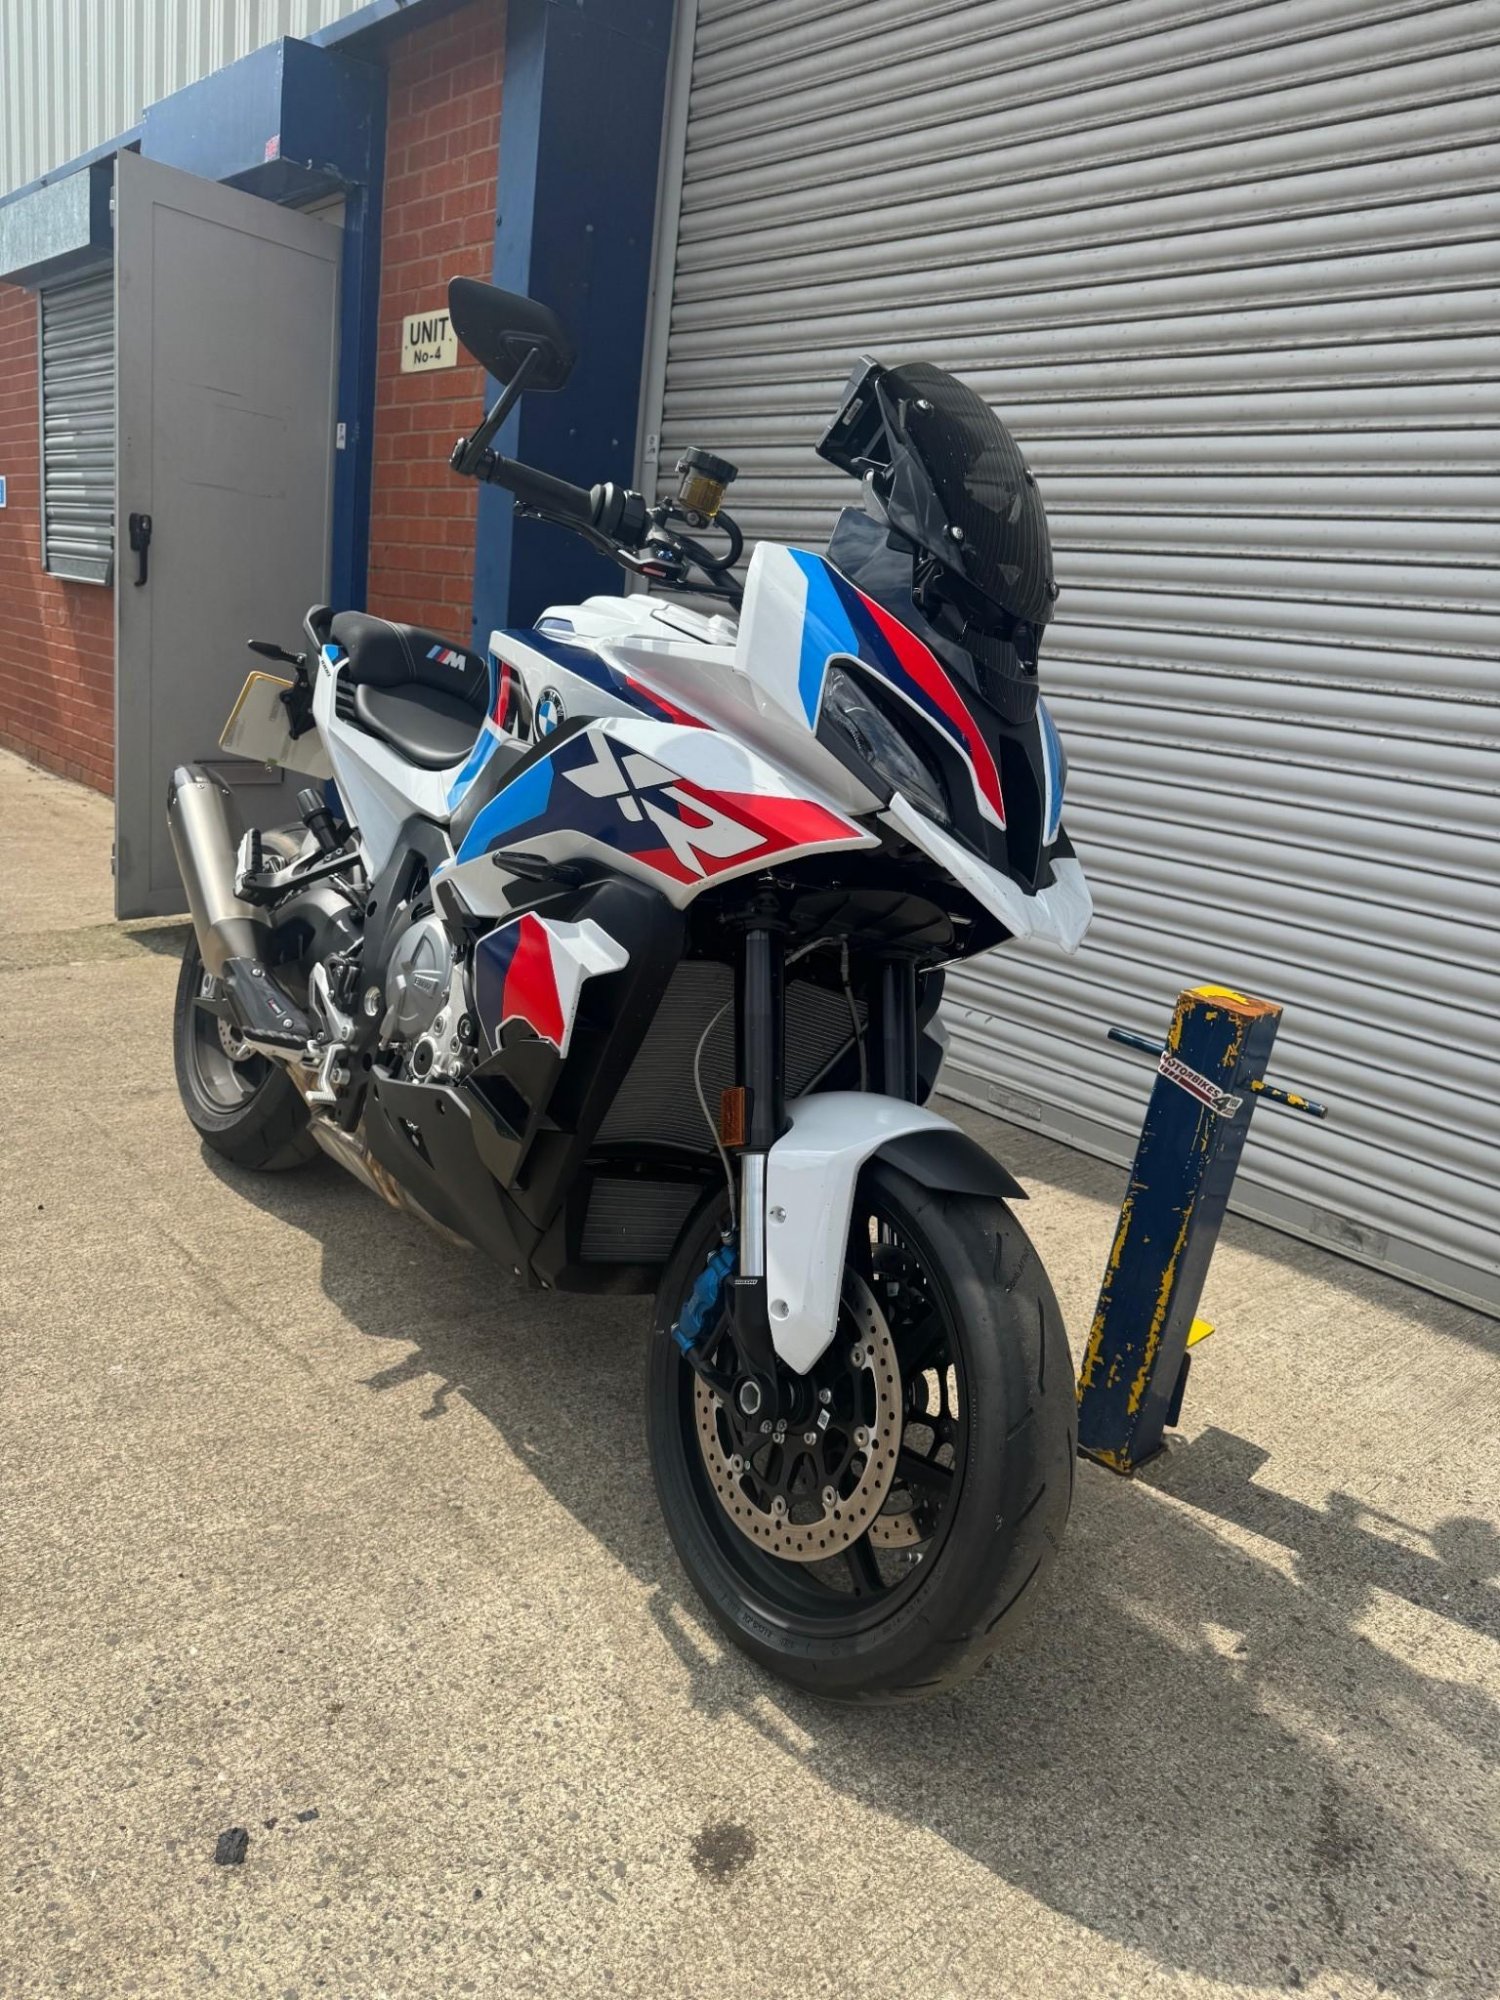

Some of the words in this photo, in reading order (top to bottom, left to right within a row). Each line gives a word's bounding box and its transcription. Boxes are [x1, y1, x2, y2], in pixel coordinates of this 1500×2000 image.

[411, 317, 449, 345] UNIT
[561, 730, 768, 878] XR
[1162, 1054, 1221, 1098] MOTORBIKES
[1212, 1096, 1232, 1112] 4
